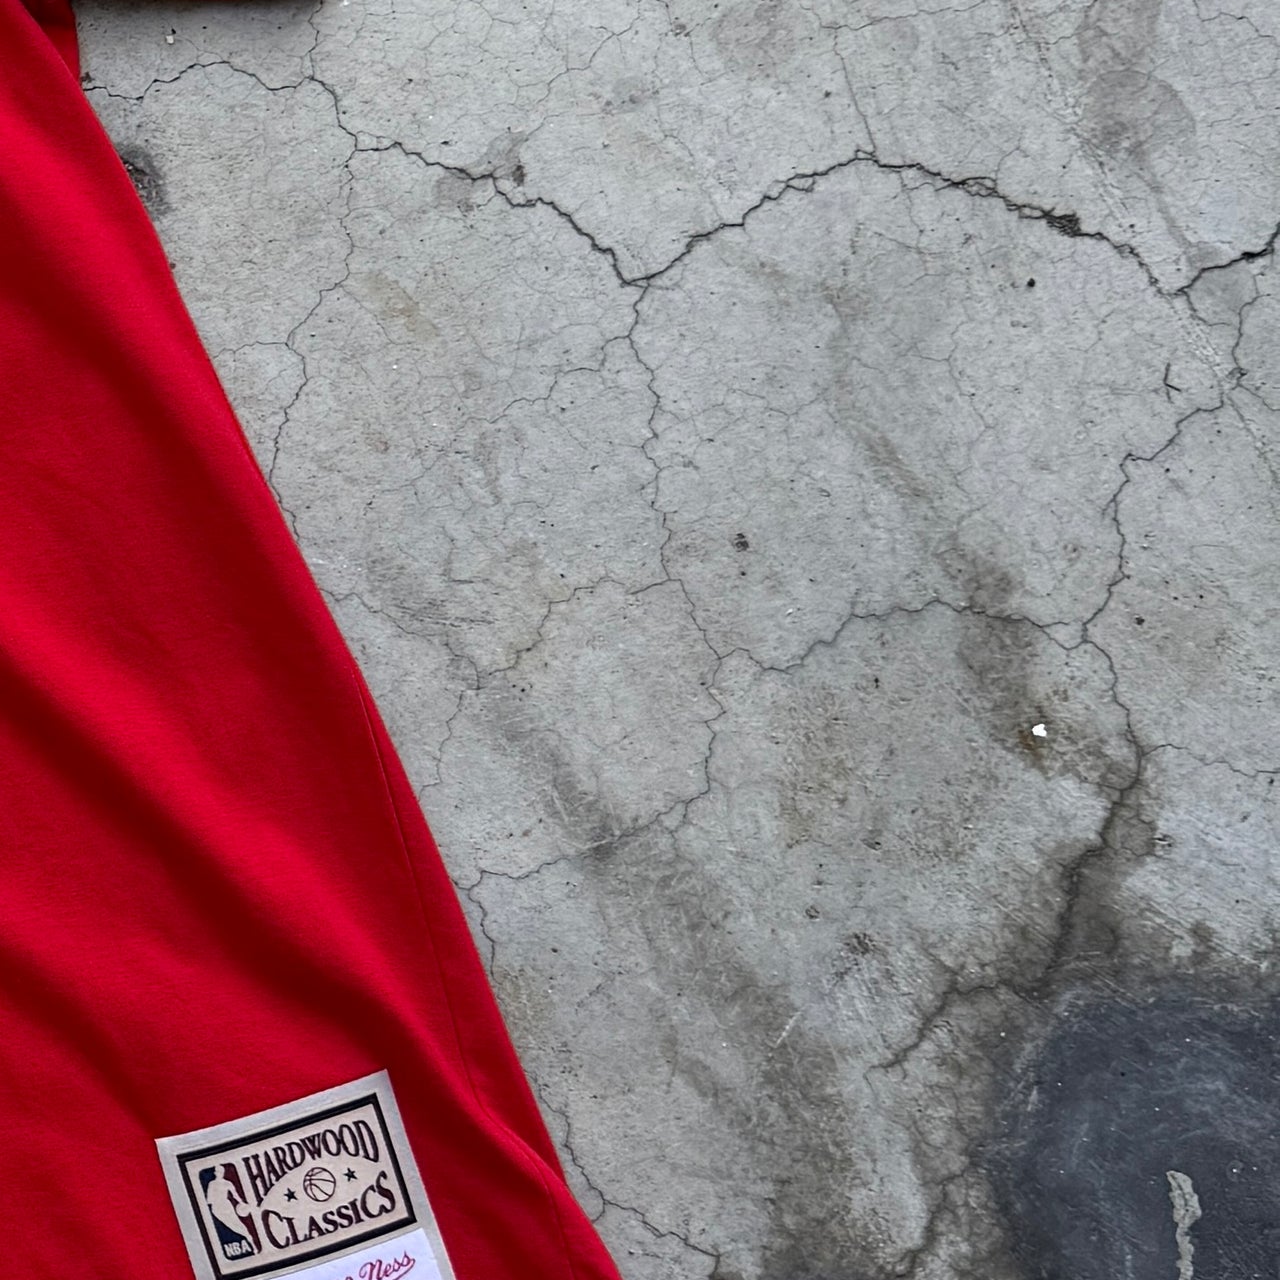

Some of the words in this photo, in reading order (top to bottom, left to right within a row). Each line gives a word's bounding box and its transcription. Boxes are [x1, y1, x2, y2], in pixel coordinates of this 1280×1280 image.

[243, 1120, 379, 1207] HARDWOOD
[224, 1241, 251, 1257] NBA
[261, 1171, 396, 1250] CLASSICS
